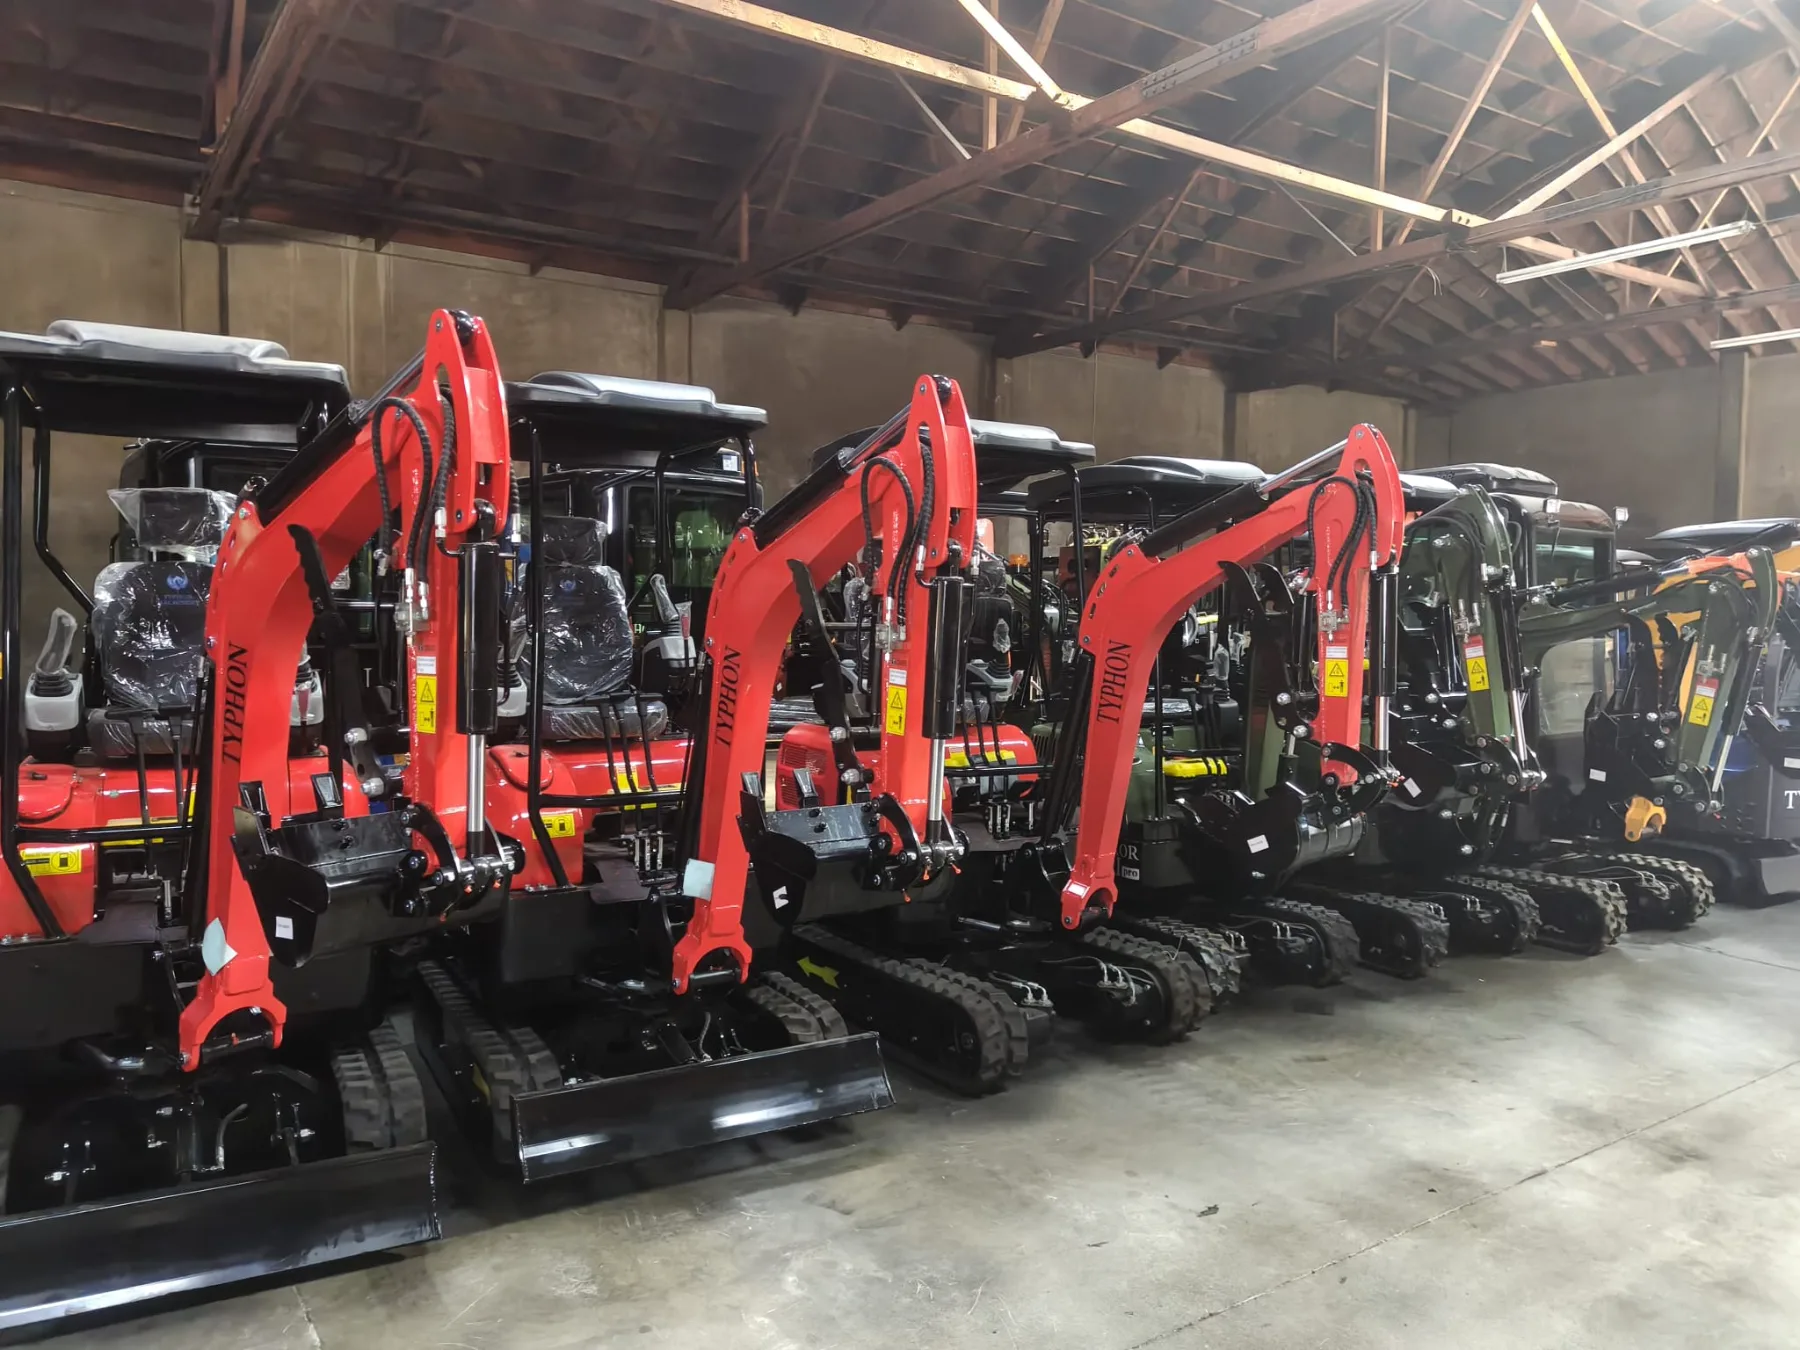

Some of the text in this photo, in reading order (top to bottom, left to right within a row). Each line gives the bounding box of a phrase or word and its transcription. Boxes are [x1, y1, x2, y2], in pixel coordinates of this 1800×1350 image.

[222, 640, 248, 764] TYPHON
[715, 644, 741, 746] TYPHON
[1097, 640, 1132, 724] TYPHON
[1784, 790, 1800, 809] T
[1117, 843, 1140, 861] OR
